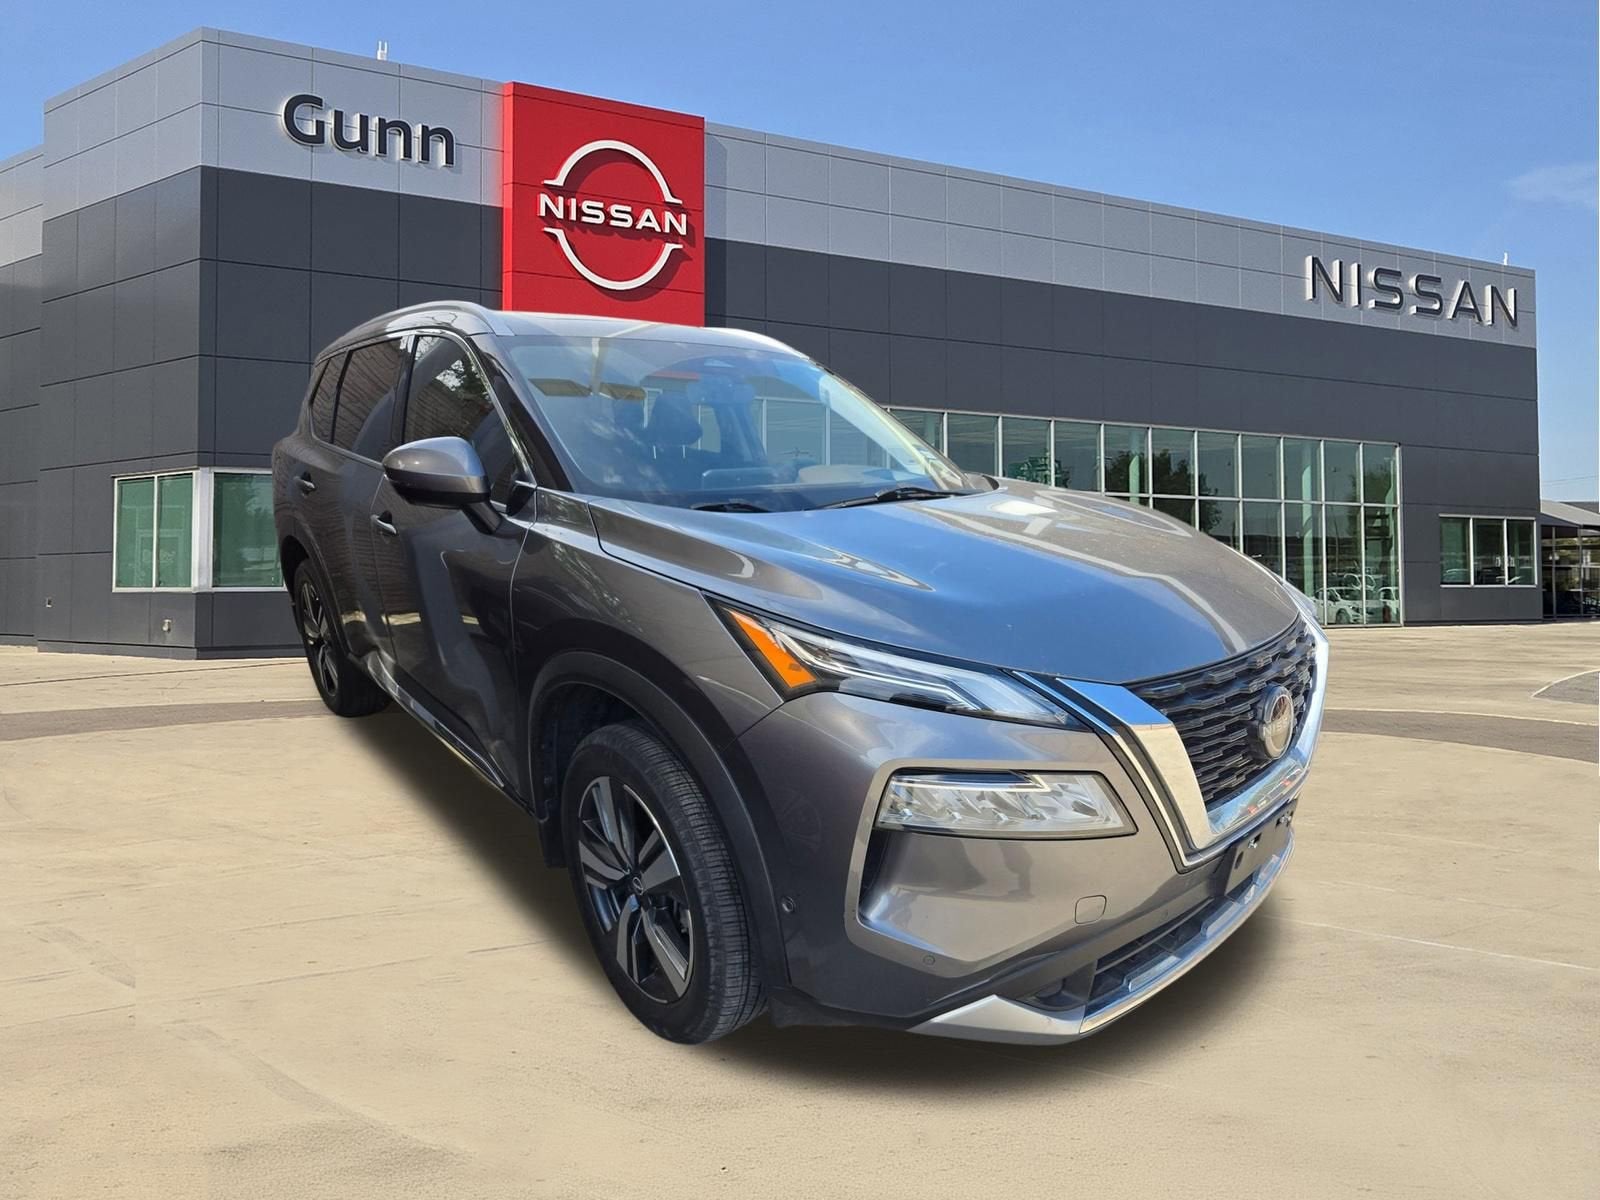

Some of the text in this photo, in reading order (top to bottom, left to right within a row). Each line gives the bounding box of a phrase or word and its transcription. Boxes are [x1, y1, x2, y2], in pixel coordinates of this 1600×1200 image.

[282, 94, 456, 168] Gunn
[537, 193, 688, 236] NISSAN
[1305, 255, 1518, 327] NISSAN
